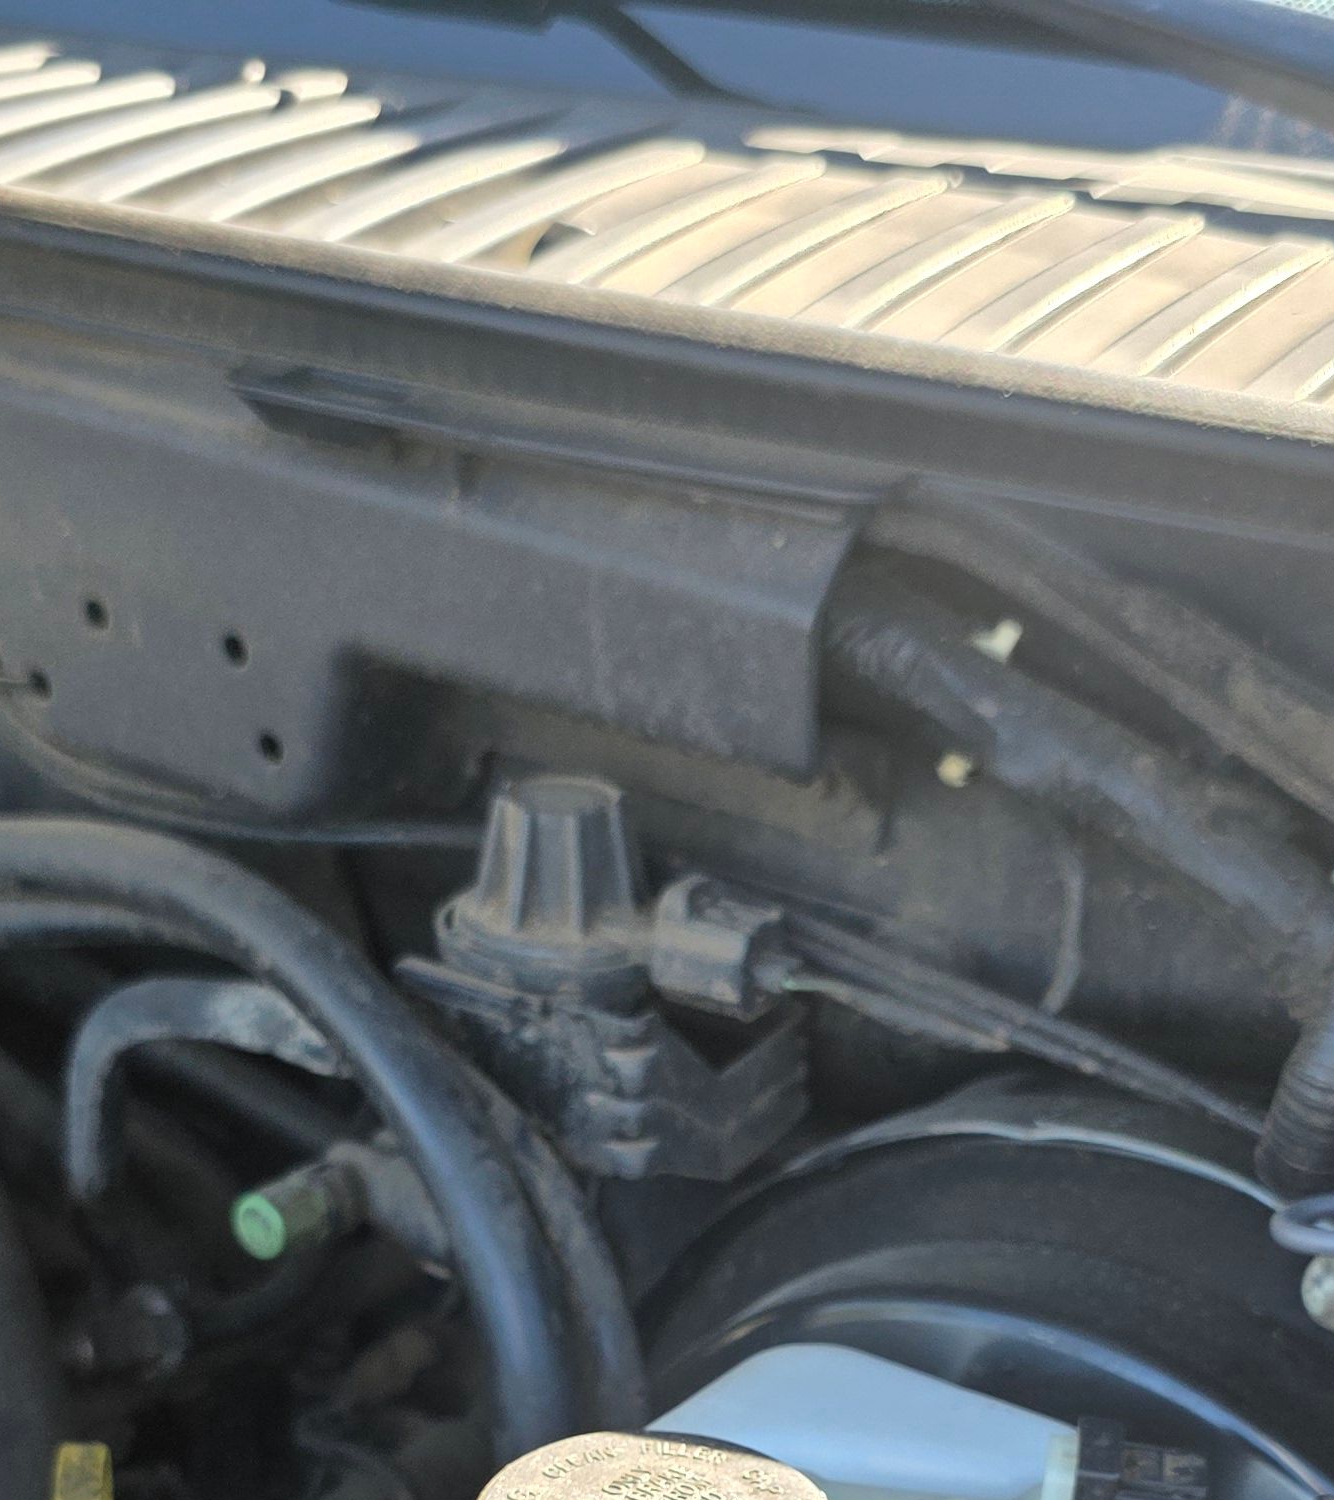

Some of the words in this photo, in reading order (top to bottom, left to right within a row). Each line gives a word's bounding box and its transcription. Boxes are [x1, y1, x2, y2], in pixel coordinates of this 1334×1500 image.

[541, 1446, 624, 1480] CLEAN
[640, 1440, 726, 1464] FILLER
[742, 1469, 785, 1495] CAP
